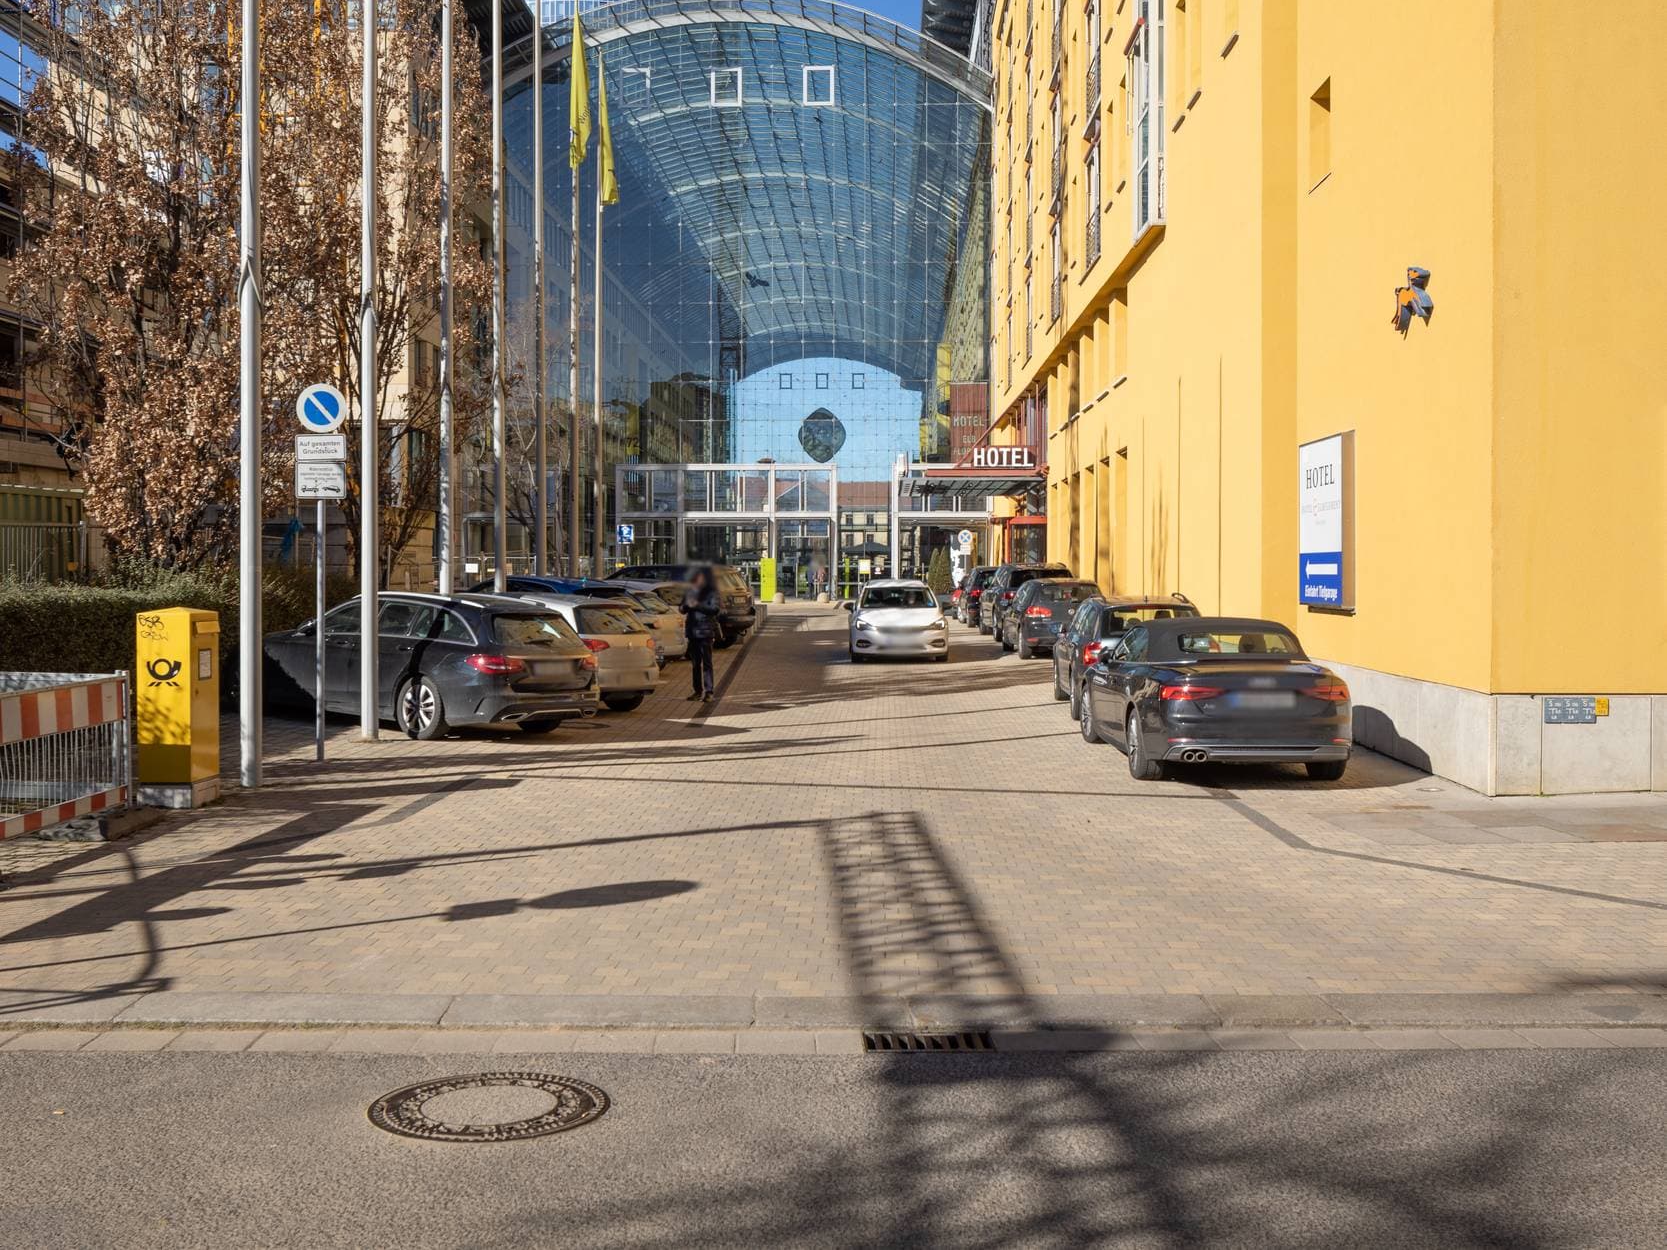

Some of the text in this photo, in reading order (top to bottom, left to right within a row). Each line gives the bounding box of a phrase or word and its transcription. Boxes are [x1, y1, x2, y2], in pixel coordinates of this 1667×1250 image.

[953, 415, 985, 427] HOTEL
[973, 447, 1034, 467] HOTEL
[1306, 463, 1335, 490] HOTEL
